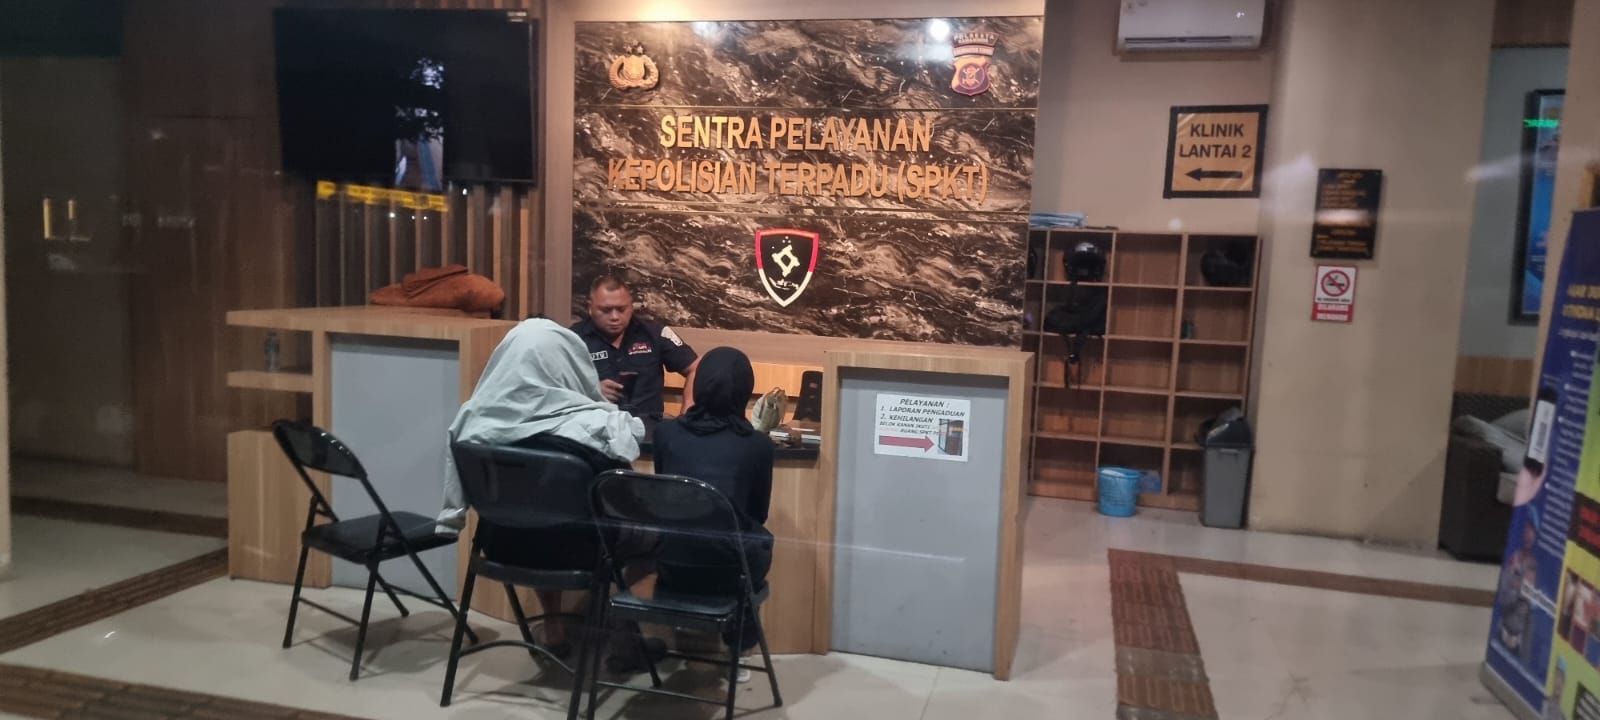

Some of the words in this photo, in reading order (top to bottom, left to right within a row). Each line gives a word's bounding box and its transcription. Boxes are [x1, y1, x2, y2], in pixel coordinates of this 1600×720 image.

[660, 114, 763, 149] SENTRA
[769, 117, 931, 152] PELAYANAN
[1190, 123, 1244, 137] KLINIK
[1179, 144, 1237, 158] LANTAI
[1241, 145, 1252, 158] 2
[608, 158, 757, 194] KEPOLISIAN
[765, 162, 888, 198] TERPADU
[897, 160, 990, 205] (SPKT)
[899, 399, 944, 408] PELAYANAN
[889, 406, 921, 414] LAPORAN
[921, 409, 965, 417] PENGADUAN
[889, 414, 933, 423] KEHILANGAN
